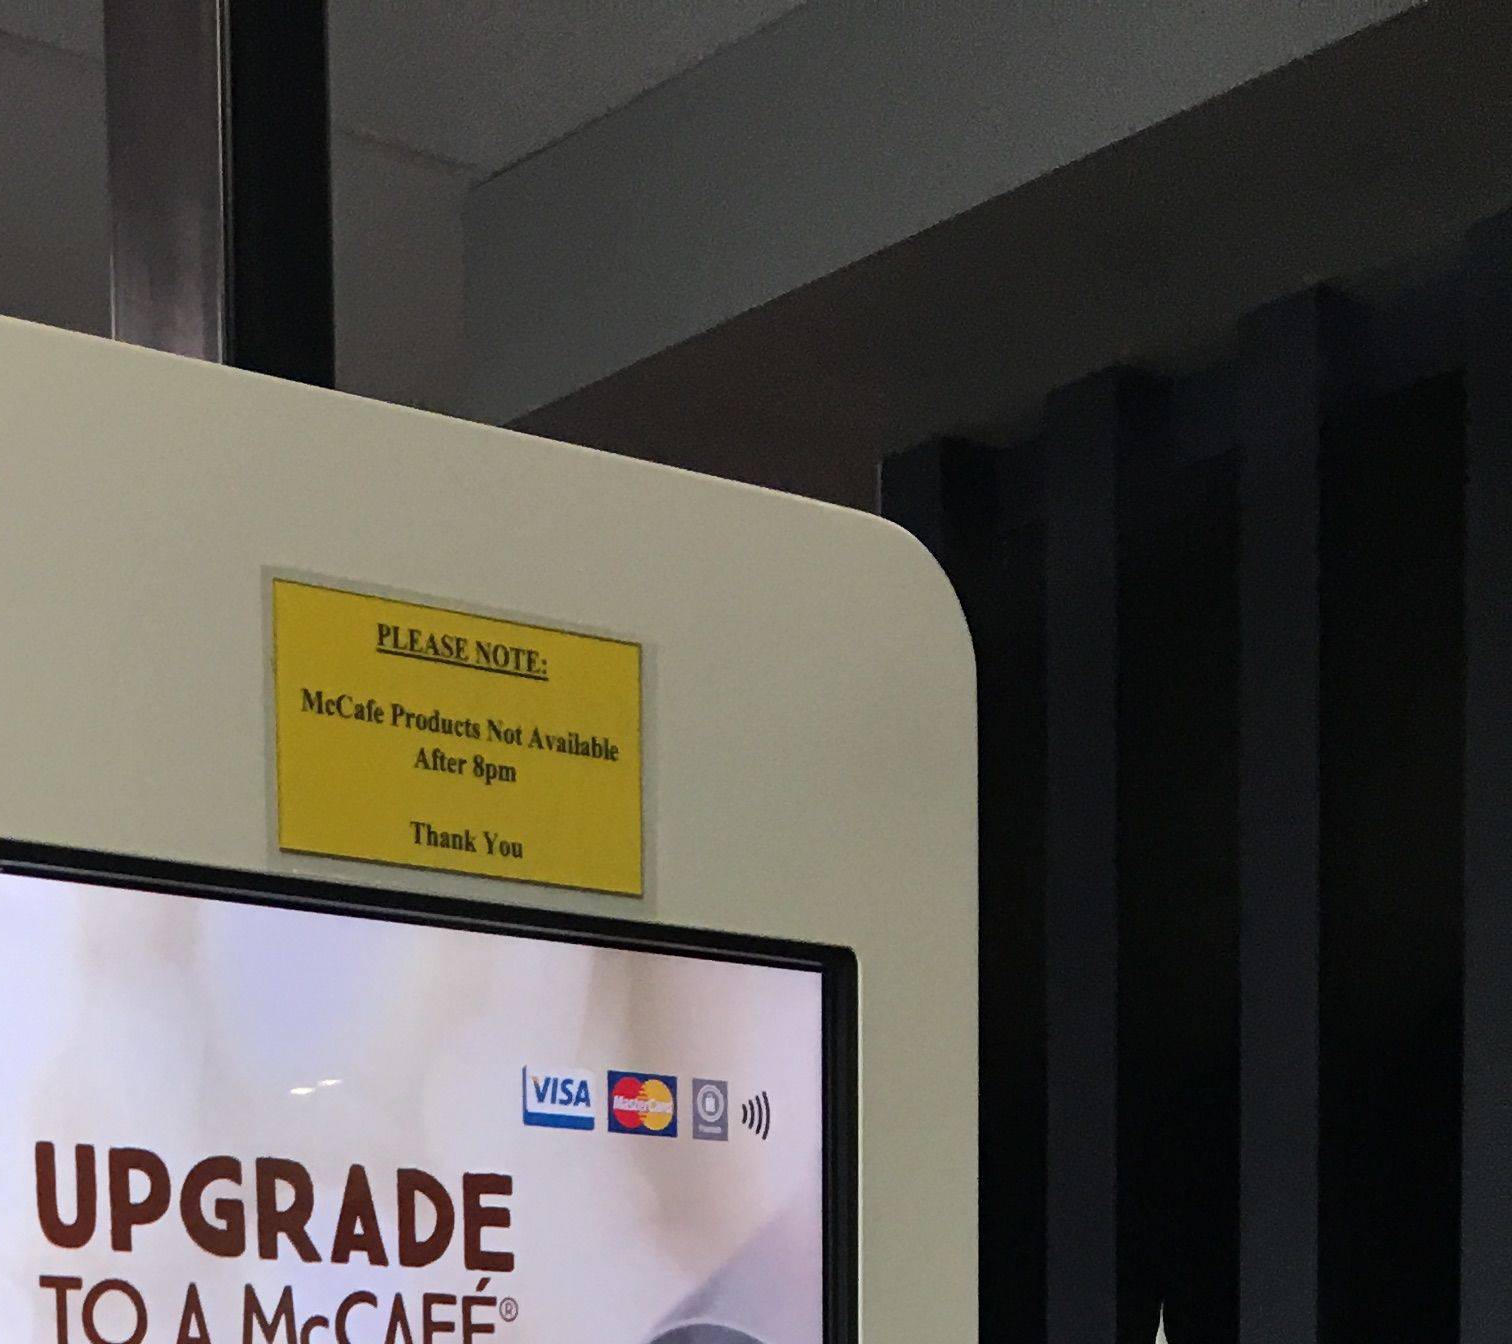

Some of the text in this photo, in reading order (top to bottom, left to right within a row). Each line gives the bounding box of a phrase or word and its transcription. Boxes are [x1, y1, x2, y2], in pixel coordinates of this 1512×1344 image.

[376, 622, 548, 677] PLEASE NOTE:
[300, 687, 620, 762] McCafe Products Not Available
[414, 747, 518, 785] After 8pm
[410, 821, 524, 859] Thank You
[531, 1076, 592, 1108] VISA
[35, 1140, 515, 1272] UPGRADE
